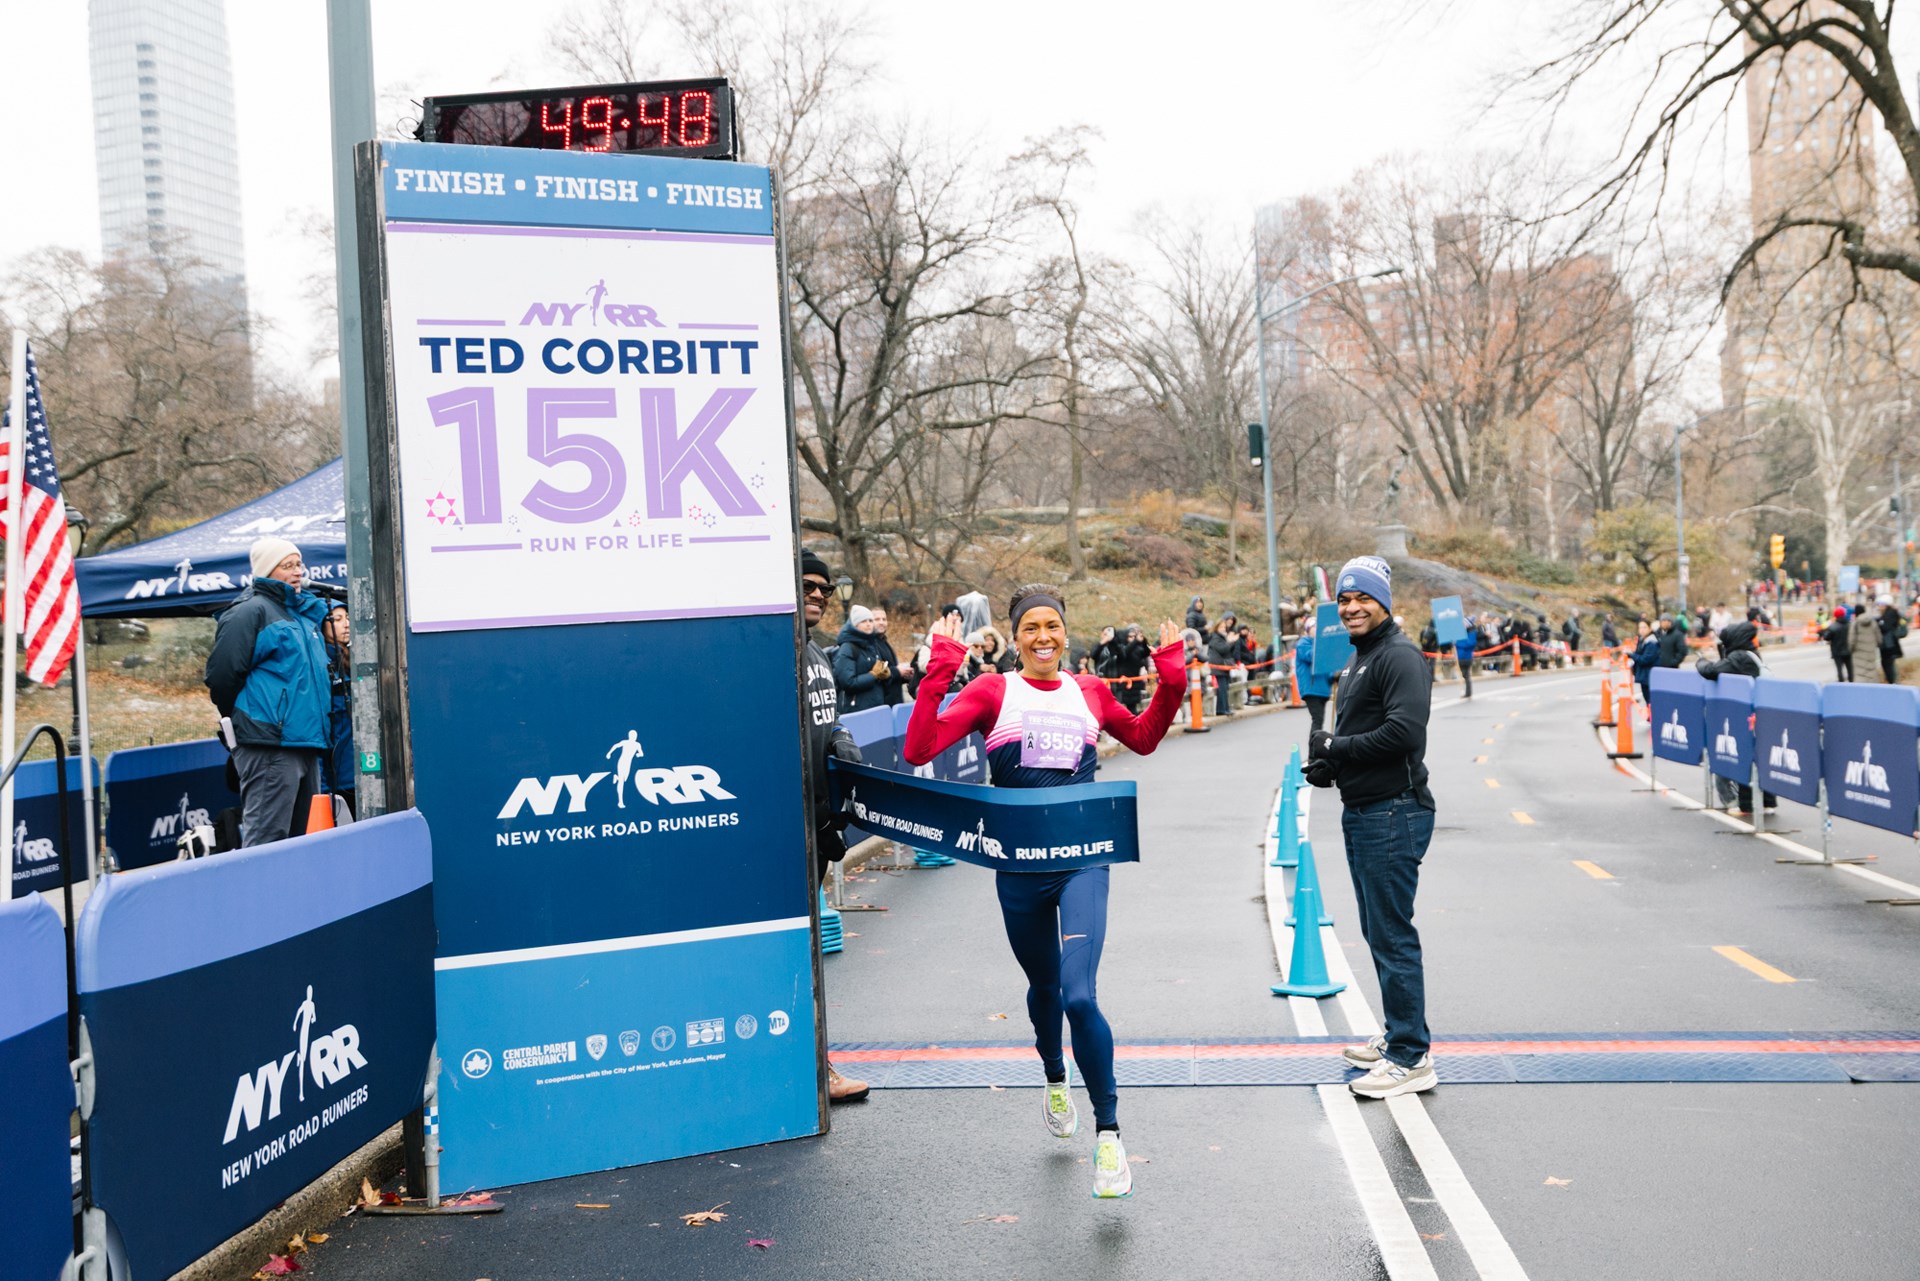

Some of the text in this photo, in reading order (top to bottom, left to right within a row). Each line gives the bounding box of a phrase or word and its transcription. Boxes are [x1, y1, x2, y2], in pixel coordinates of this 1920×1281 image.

[395, 168, 763, 209] FINISH FINISH FINISH
[419, 337, 759, 375] TED CORBITT
[426, 386, 767, 524] 15K
[530, 533, 683, 552] RUN FOR LIFE
[1040, 731, 1084, 754] 3552
[366, 754, 376, 768] 8
[496, 765, 738, 819] NYRR
[496, 812, 740, 847] NEW YORK ROAD RUNNERS
[868, 810, 881, 825] NEW
[881, 814, 897, 829] YORK
[896, 818, 913, 833] ROAD
[912, 823, 944, 842] RUNNERS
[1015, 847, 1047, 860] RUN
[1050, 845, 1082, 859] FOR
[1084, 840, 1114, 856] LIFE
[31, 863, 60, 877] RUNNERS
[769, 1017, 786, 1030] MTA
[503, 1042, 568, 1060] CENTRAL PARK
[503, 1053, 569, 1070] CONSERVANCY
[544, 1073, 584, 1084] cooperation
[586, 1070, 600, 1079] with
[613, 1067, 627, 1076] City
[707, 1053, 727, 1063] Mayor
[222, 1084, 368, 1189] NEW YORK ROAD RUNNERS
